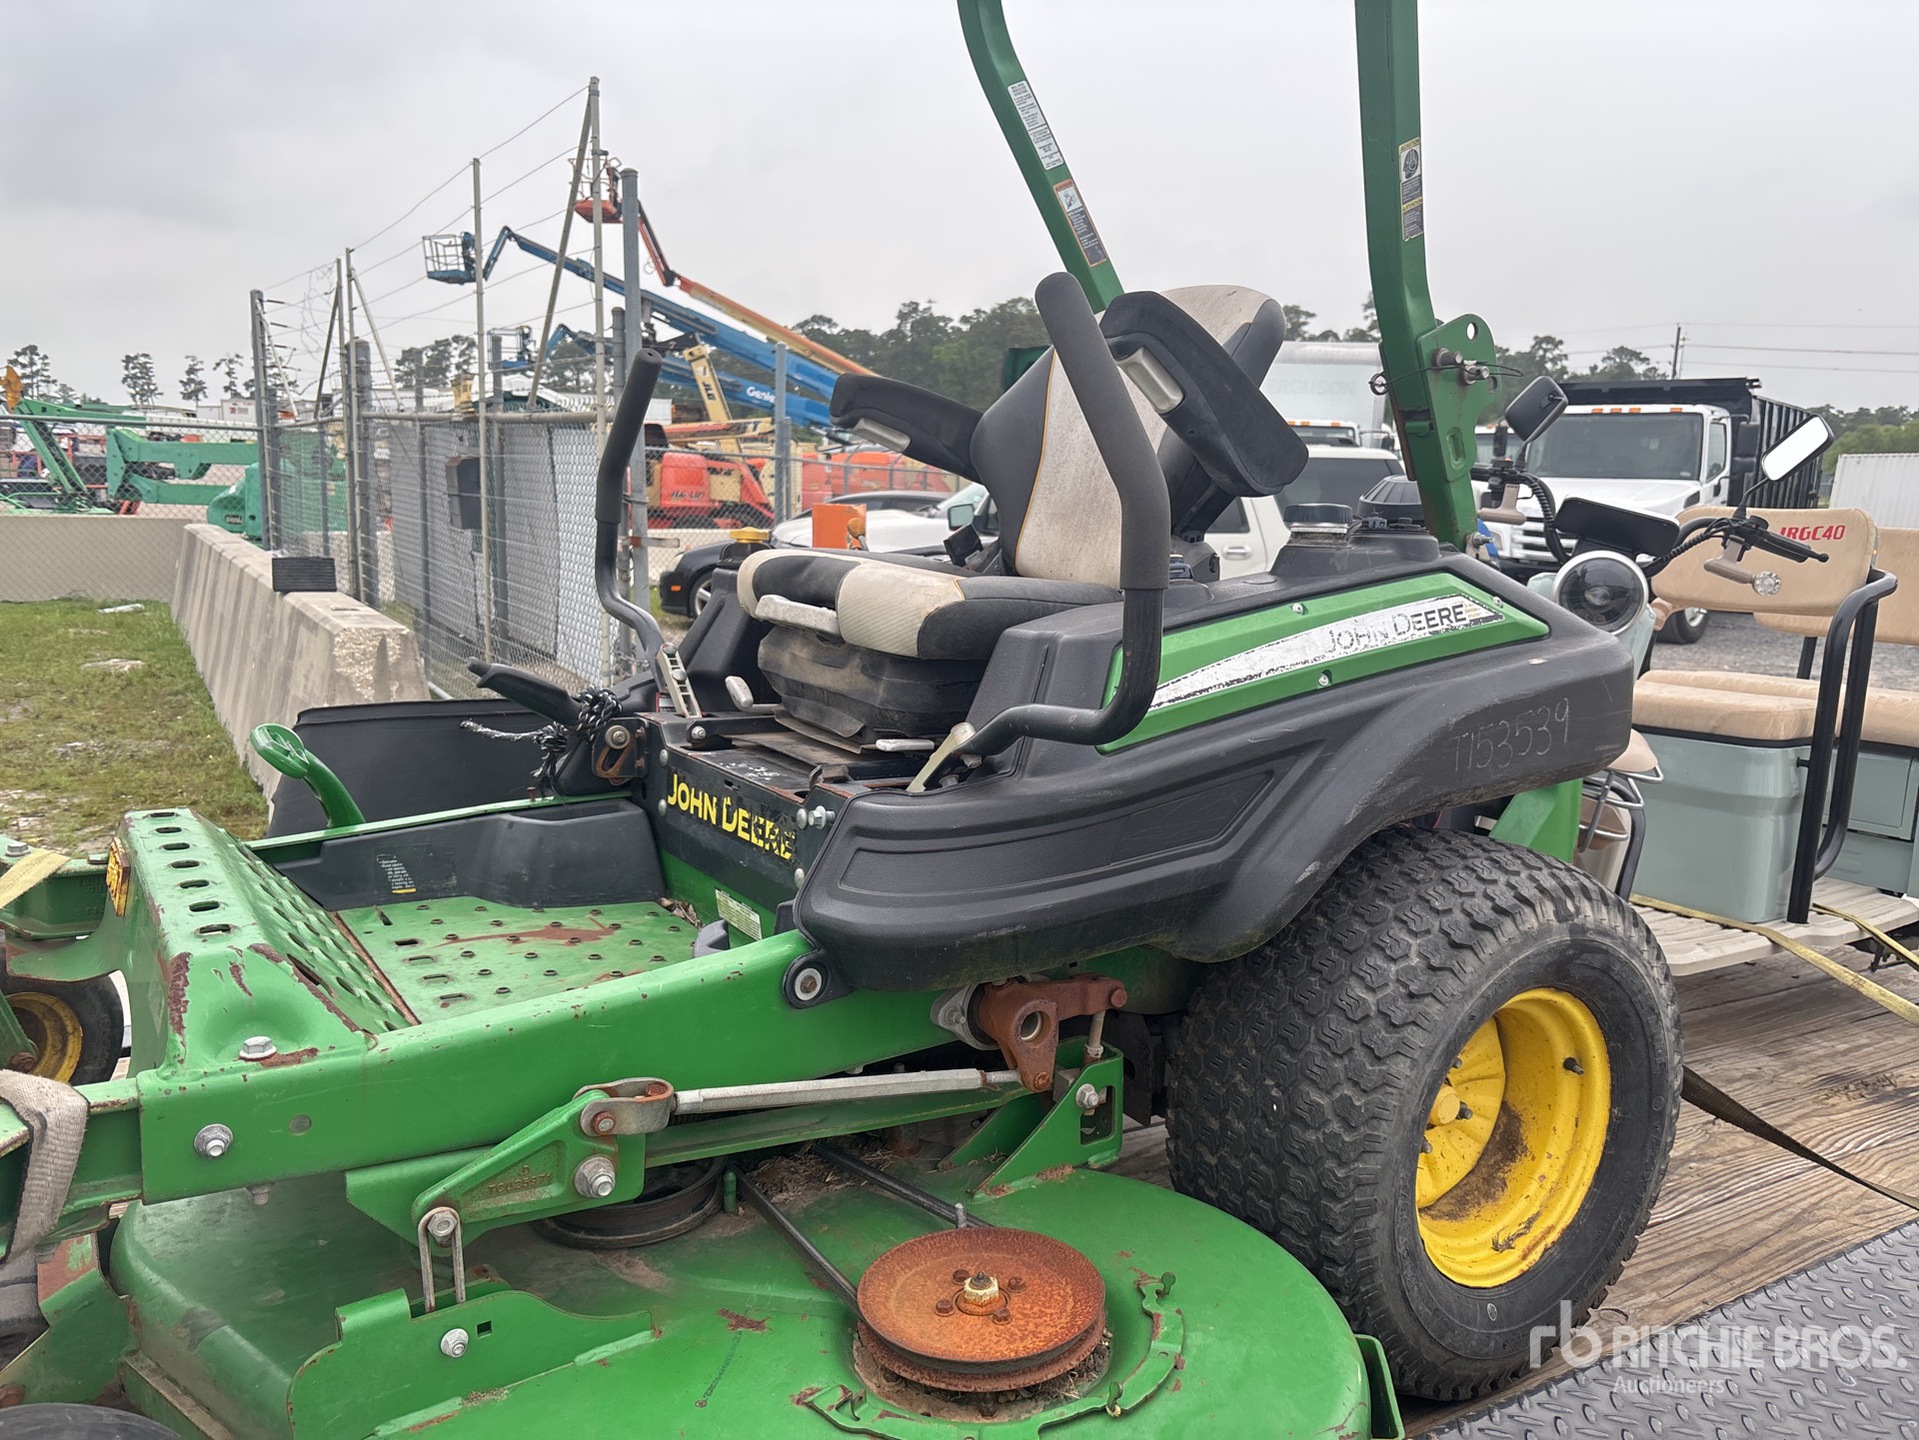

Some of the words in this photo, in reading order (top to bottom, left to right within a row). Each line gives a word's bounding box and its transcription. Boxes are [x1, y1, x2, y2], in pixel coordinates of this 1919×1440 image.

[1393, 603, 1468, 637] DEERE
[667, 773, 718, 826] JOHN
[722, 796, 797, 860] DEERE
